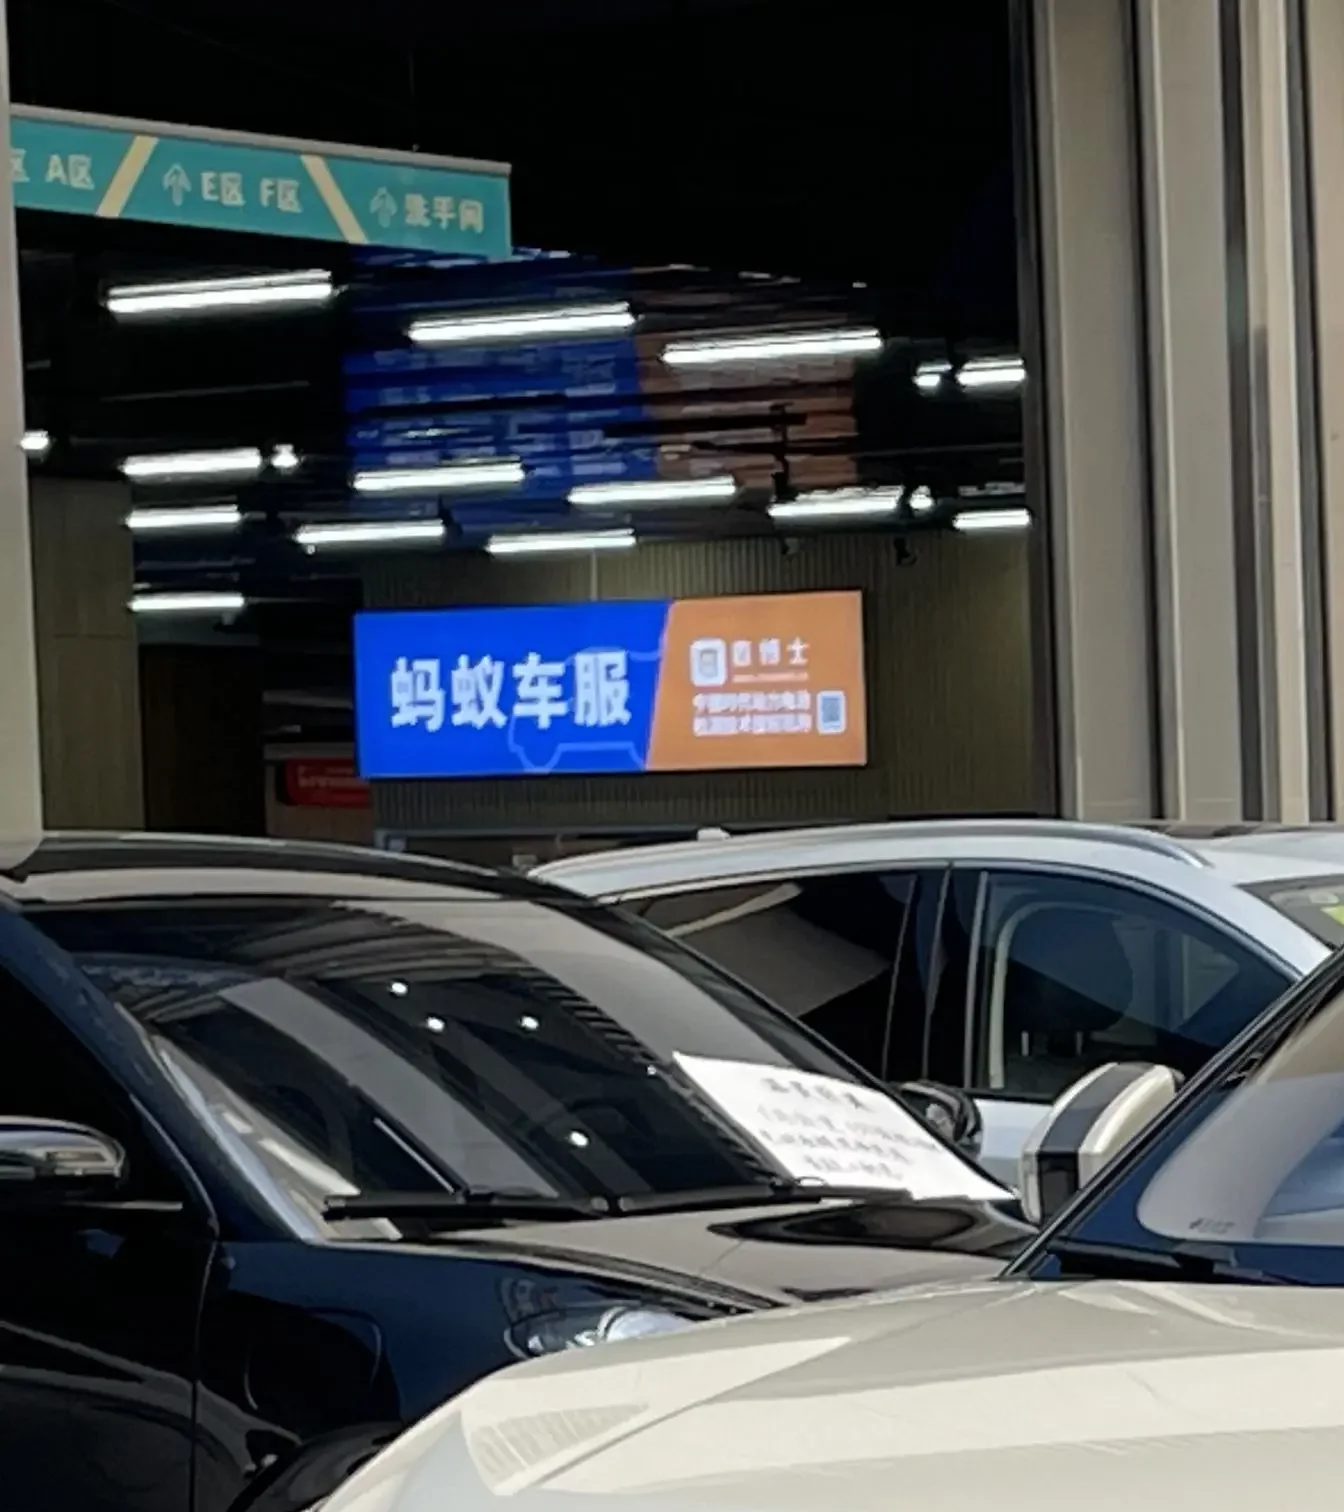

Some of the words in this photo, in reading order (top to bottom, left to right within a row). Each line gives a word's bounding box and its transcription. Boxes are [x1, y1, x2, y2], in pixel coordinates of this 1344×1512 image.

[200, 171, 246, 207] E区
[259, 177, 303, 213] F区
[390, 650, 632, 733] 蚂蚁车服
